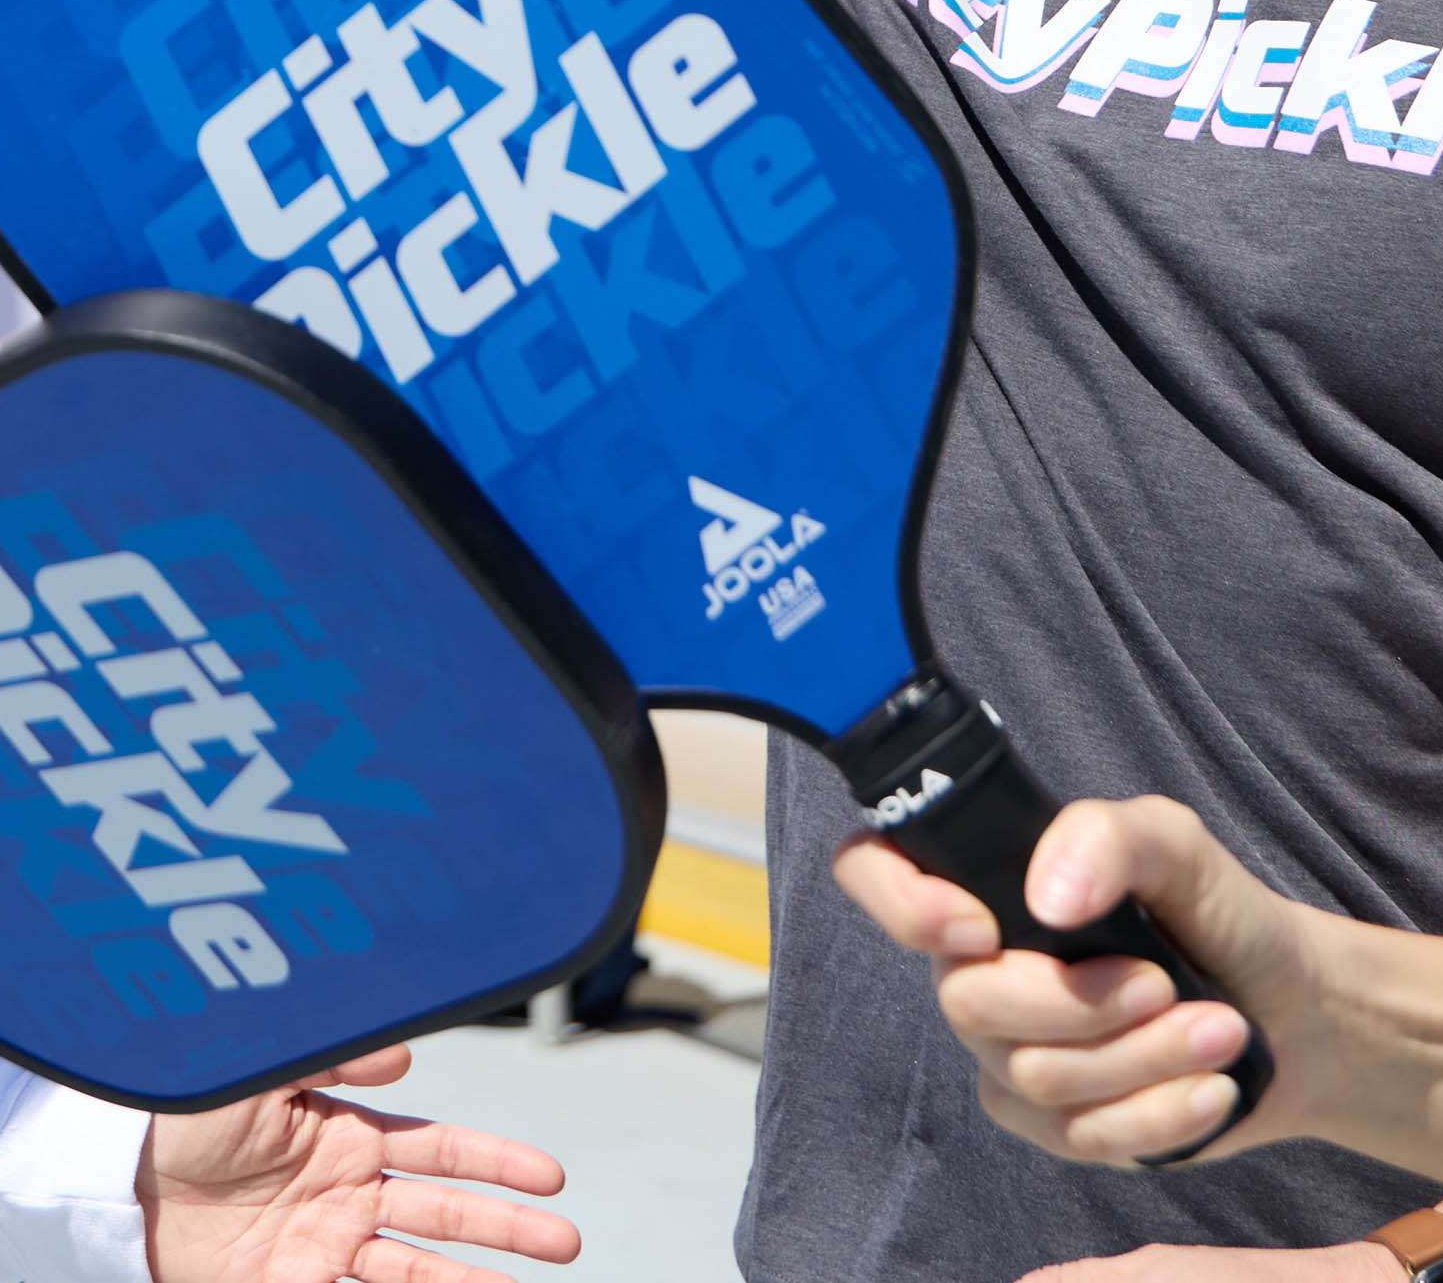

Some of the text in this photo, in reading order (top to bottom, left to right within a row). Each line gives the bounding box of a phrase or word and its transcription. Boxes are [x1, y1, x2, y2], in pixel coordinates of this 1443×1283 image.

[430, 113, 839, 485] ickle
[33, 550, 349, 855] City
[702, 512, 826, 621] JOOLA
